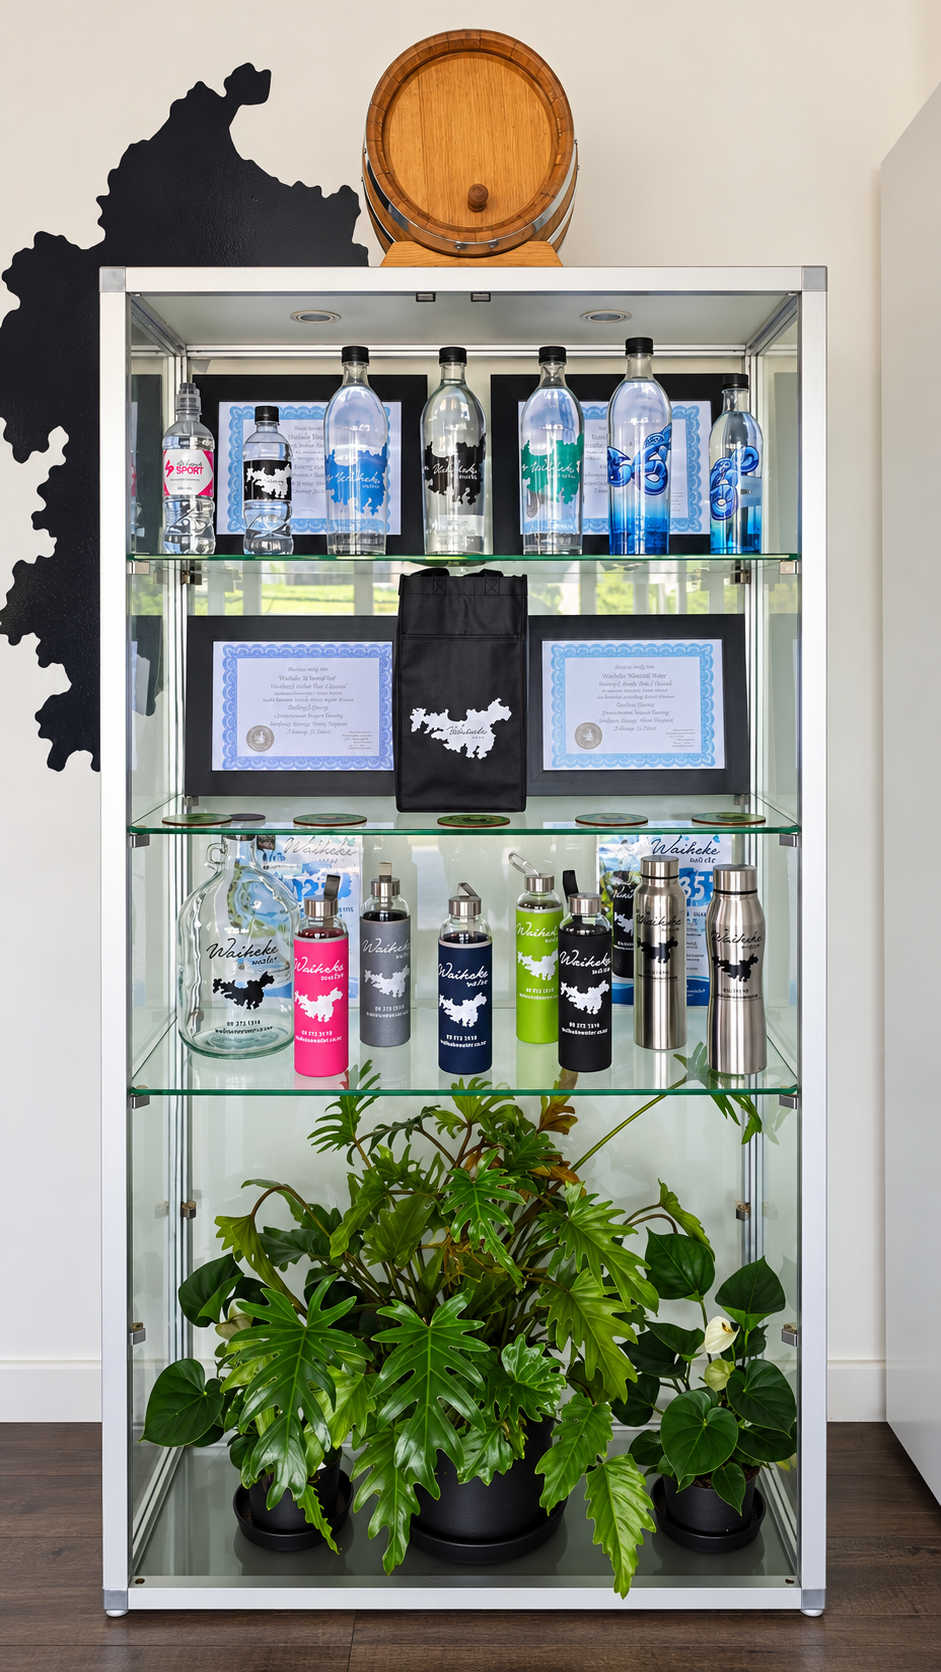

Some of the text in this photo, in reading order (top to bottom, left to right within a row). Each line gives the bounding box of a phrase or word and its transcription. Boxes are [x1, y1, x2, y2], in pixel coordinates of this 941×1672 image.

[176, 466, 204, 475] SPORT
[651, 835, 720, 856] Waiheke
[206, 937, 279, 961] Waiheke
